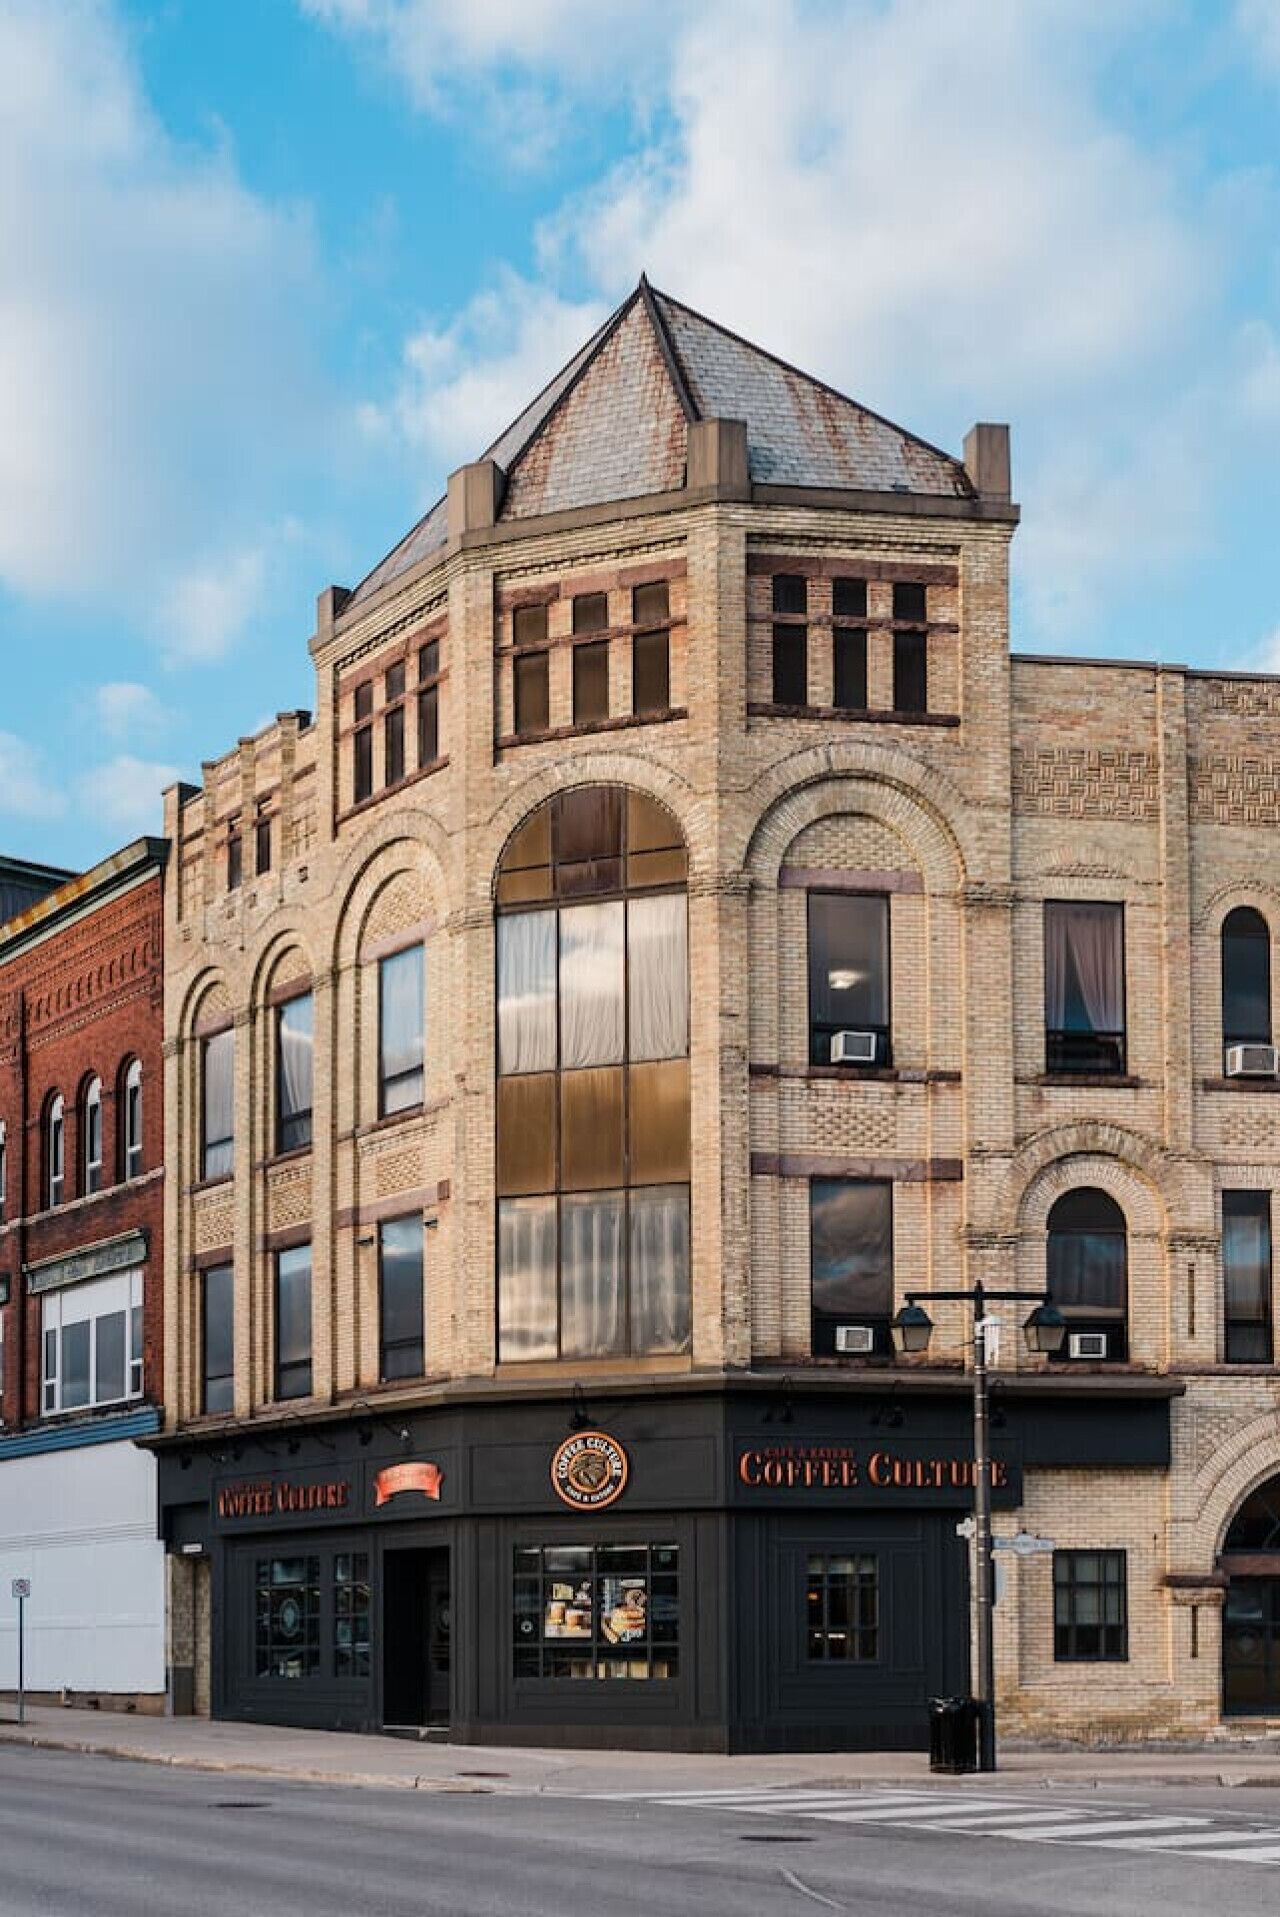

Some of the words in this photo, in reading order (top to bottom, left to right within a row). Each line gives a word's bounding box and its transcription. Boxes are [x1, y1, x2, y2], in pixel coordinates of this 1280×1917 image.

[558, 1439, 585, 1479] COFFEE
[586, 1437, 622, 1477] CULTURE
[738, 1452, 858, 1488] COFFEE
[218, 1486, 273, 1518] COFFEE
[277, 1481, 348, 1512] CULTURE
